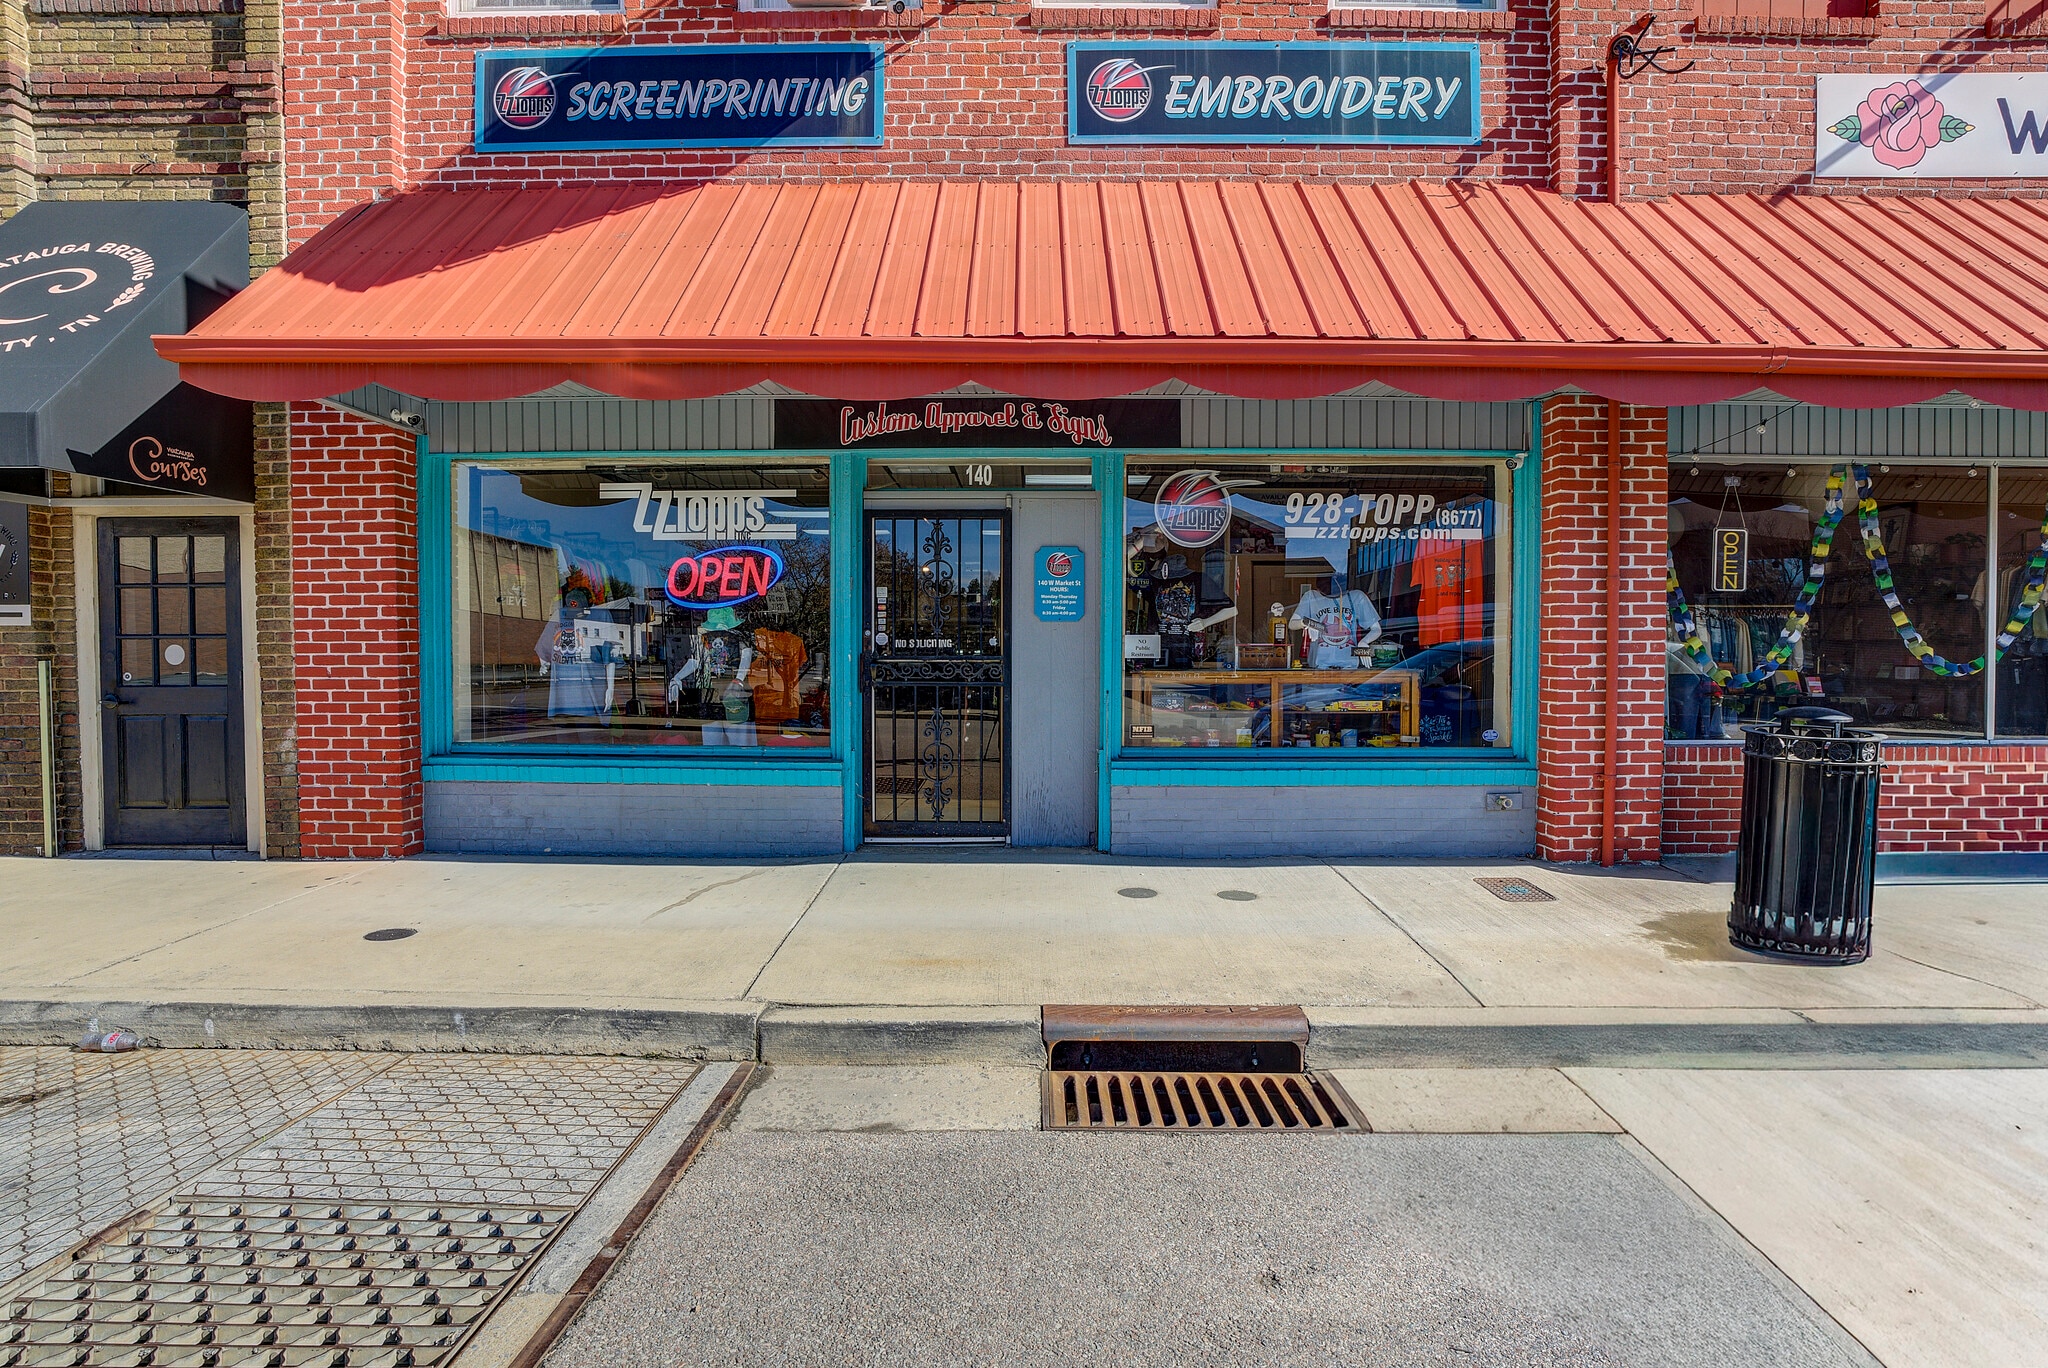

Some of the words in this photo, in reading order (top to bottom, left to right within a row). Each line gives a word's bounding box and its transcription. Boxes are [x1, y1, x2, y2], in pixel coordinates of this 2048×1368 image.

[567, 77, 869, 121] SCREENPRINTING
[1165, 75, 1462, 121] EMBROIDERY
[95, 242, 155, 281] BREWING
[59, 314, 101, 333] TN
[841, 402, 922, 445] Custom
[924, 402, 1018, 433] Apparel
[1021, 403, 1043, 429] &
[1043, 403, 1112, 446] Signs
[128, 436, 207, 486] Courses
[966, 464, 992, 486] 140
[1284, 492, 1435, 525] 928-TOPP
[1436, 508, 1482, 528] (8677)
[1316, 524, 1451, 543] zztopps.com
[667, 556, 772, 598] OPEN
[1722, 531, 1740, 590] OPEN
[1315, 607, 1332, 619] LOVE
[895, 639, 907, 648] NO
